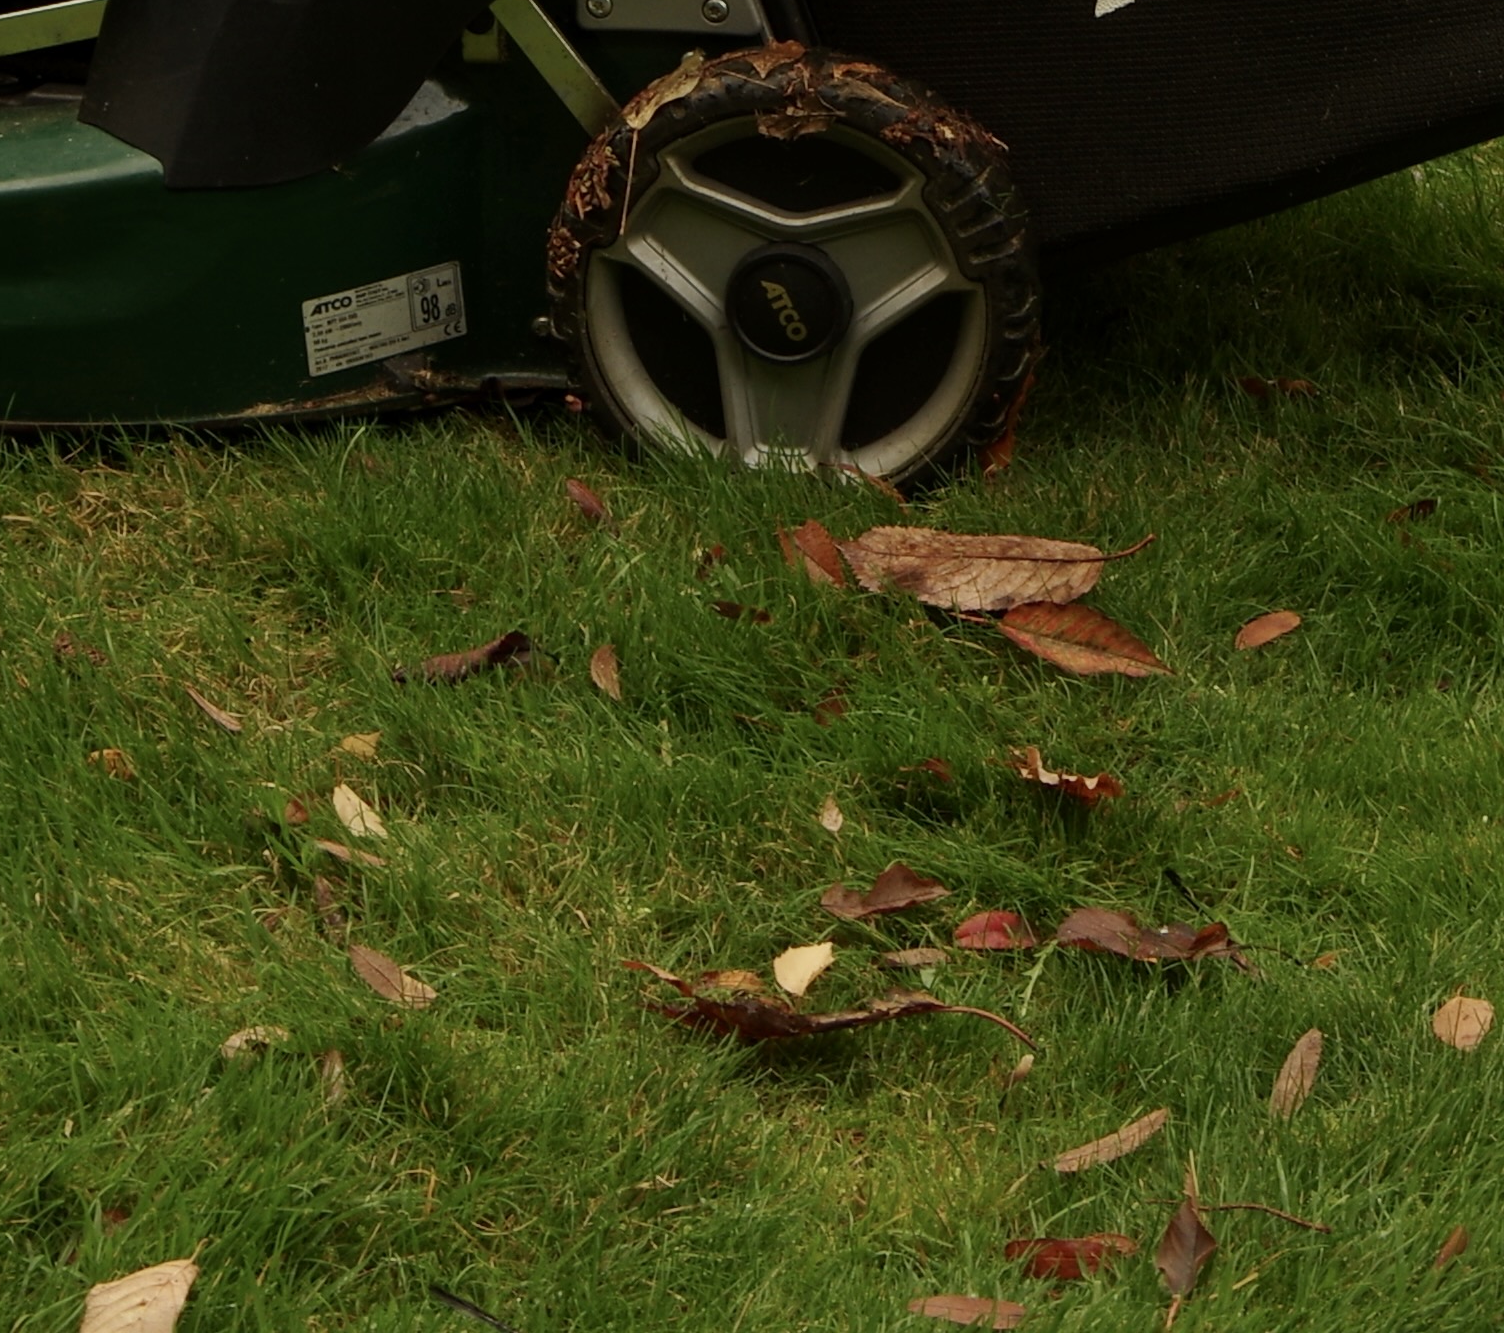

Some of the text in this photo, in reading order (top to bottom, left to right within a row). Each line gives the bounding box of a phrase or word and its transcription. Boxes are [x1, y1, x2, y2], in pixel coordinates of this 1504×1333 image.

[310, 296, 352, 317] ATCO
[421, 294, 440, 323] 98
[760, 280, 808, 341] ATCO
